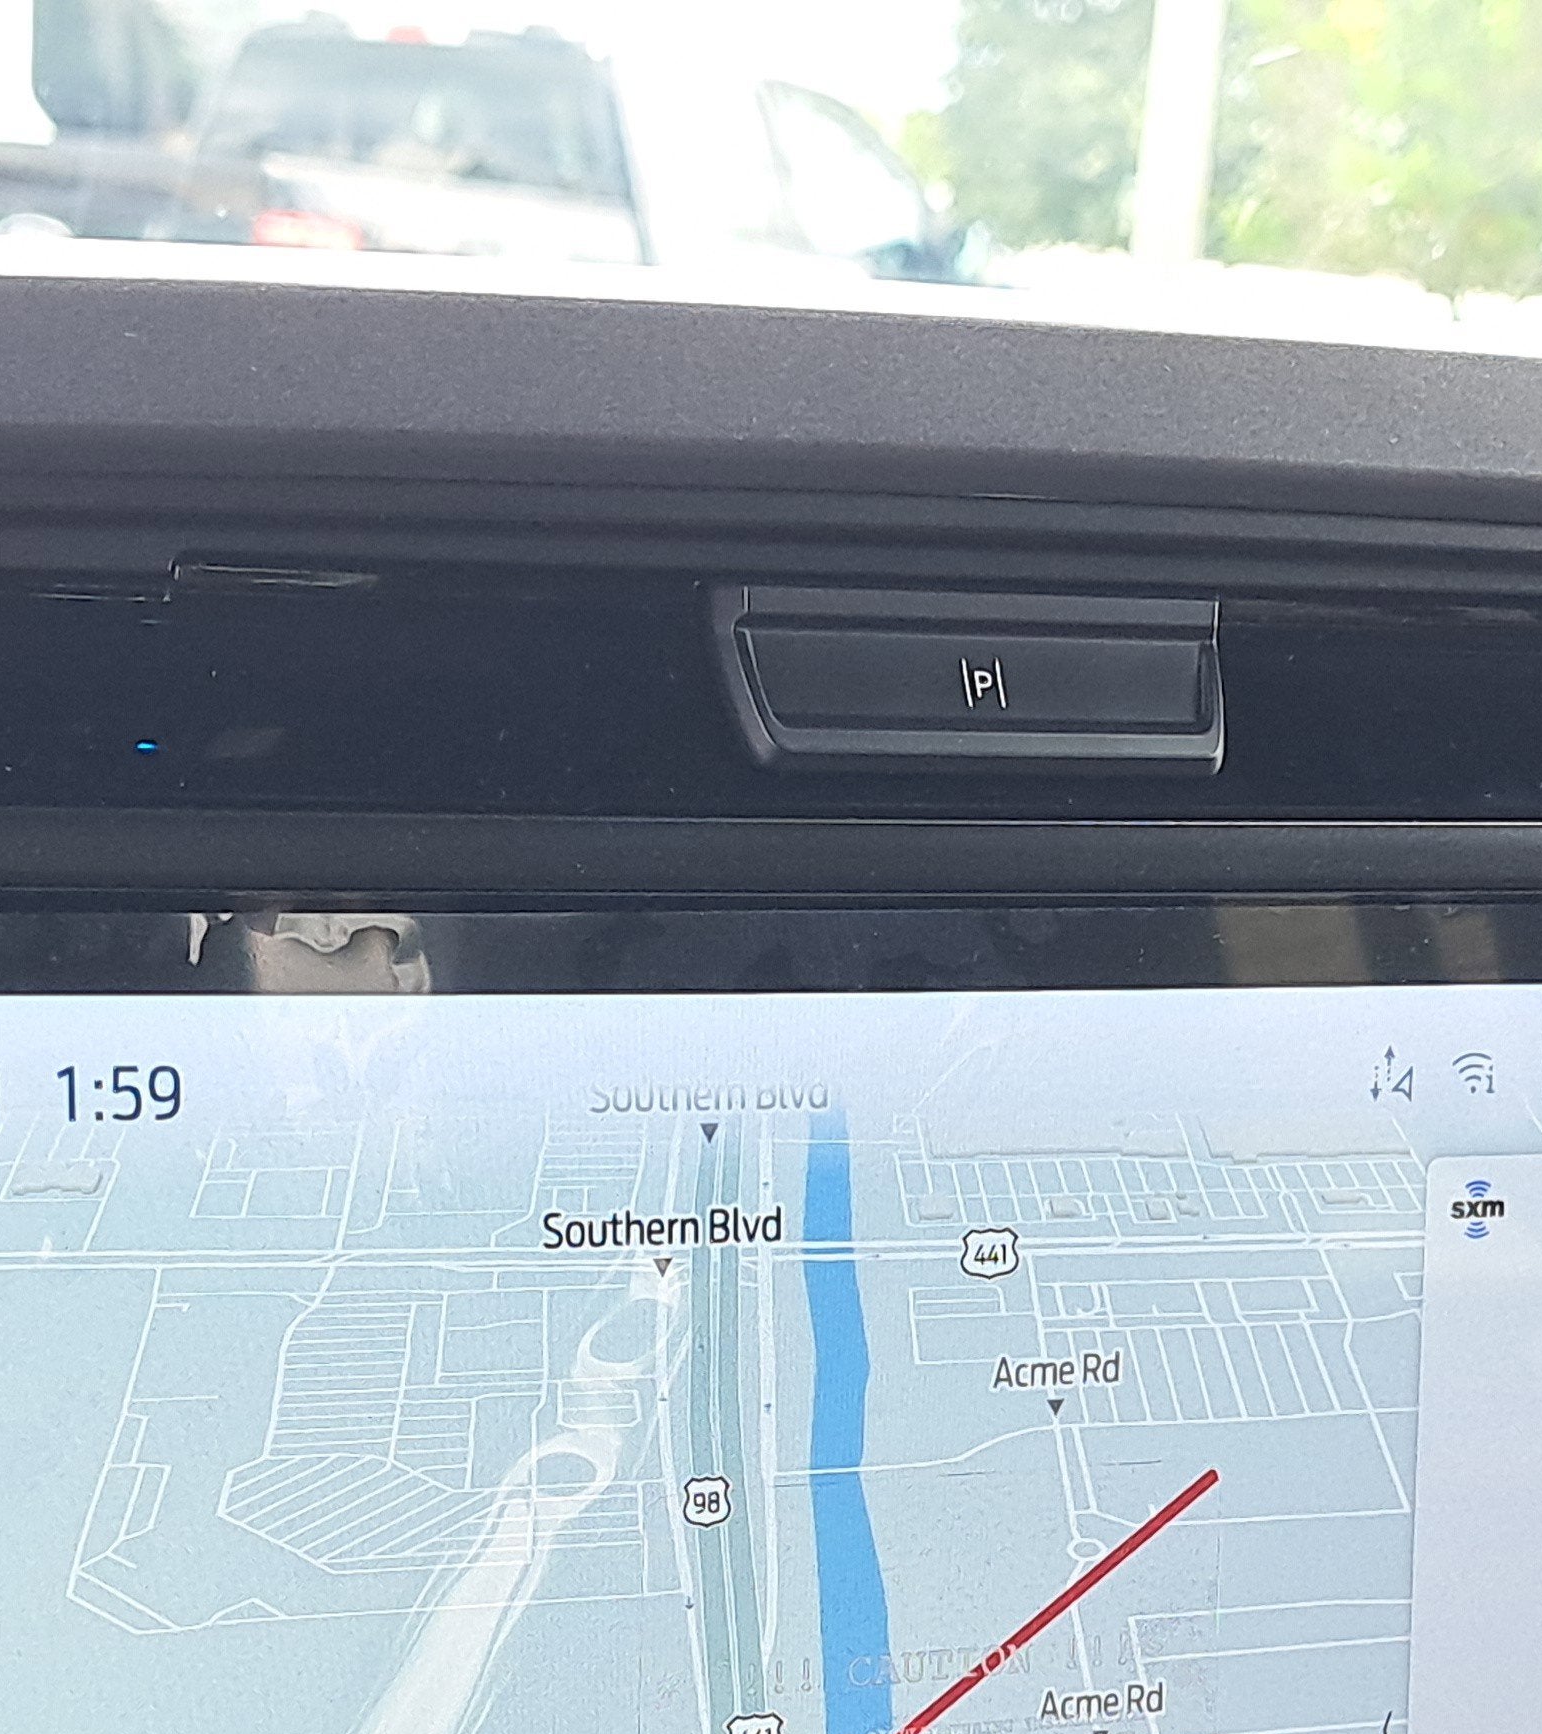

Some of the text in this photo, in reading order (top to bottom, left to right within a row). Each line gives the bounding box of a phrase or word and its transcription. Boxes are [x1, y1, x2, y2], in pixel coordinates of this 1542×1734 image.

[56, 1065, 183, 1122] 1:59
[542, 1206, 783, 1250] Southern Blvd
[972, 1243, 1008, 1267] 441
[992, 1351, 1122, 1389] Acme Rd
[693, 1491, 721, 1516] 98
[1040, 1681, 1164, 1721] Acme Rd
